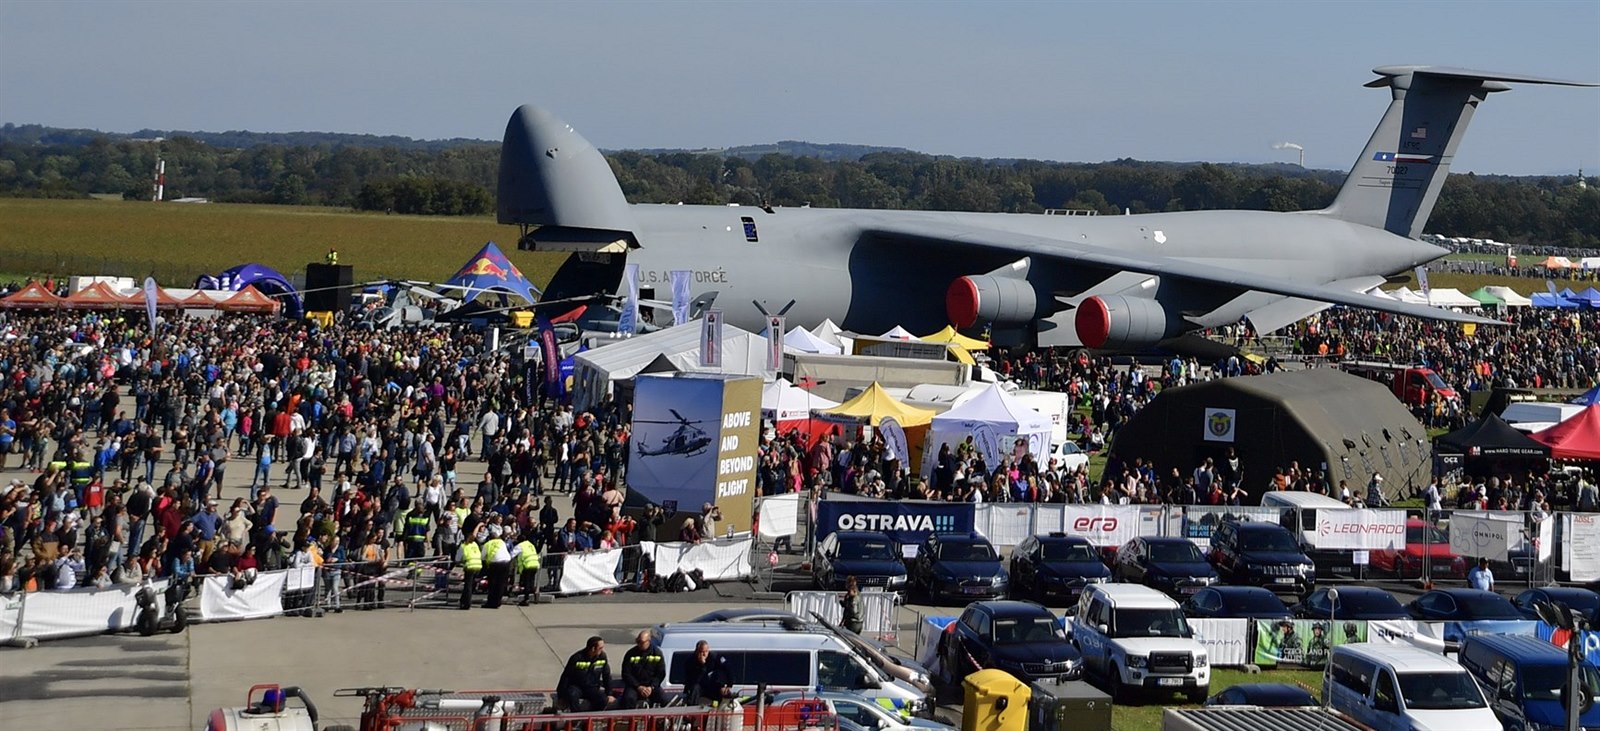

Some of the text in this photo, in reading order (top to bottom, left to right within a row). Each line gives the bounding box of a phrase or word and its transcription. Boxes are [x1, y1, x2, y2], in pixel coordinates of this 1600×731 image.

[695, 270, 728, 283] ORCE
[723, 411, 751, 429] ABOVE
[721, 435, 738, 452] AND
[720, 455, 753, 475] BEYOND
[718, 479, 748, 498] FLIGHT
[838, 514, 954, 531] OSTRAVA!!!
[1074, 517, 1117, 531] era
[1334, 524, 1404, 534] LEONARDO
[1474, 531, 1503, 540] OMNIPOL
